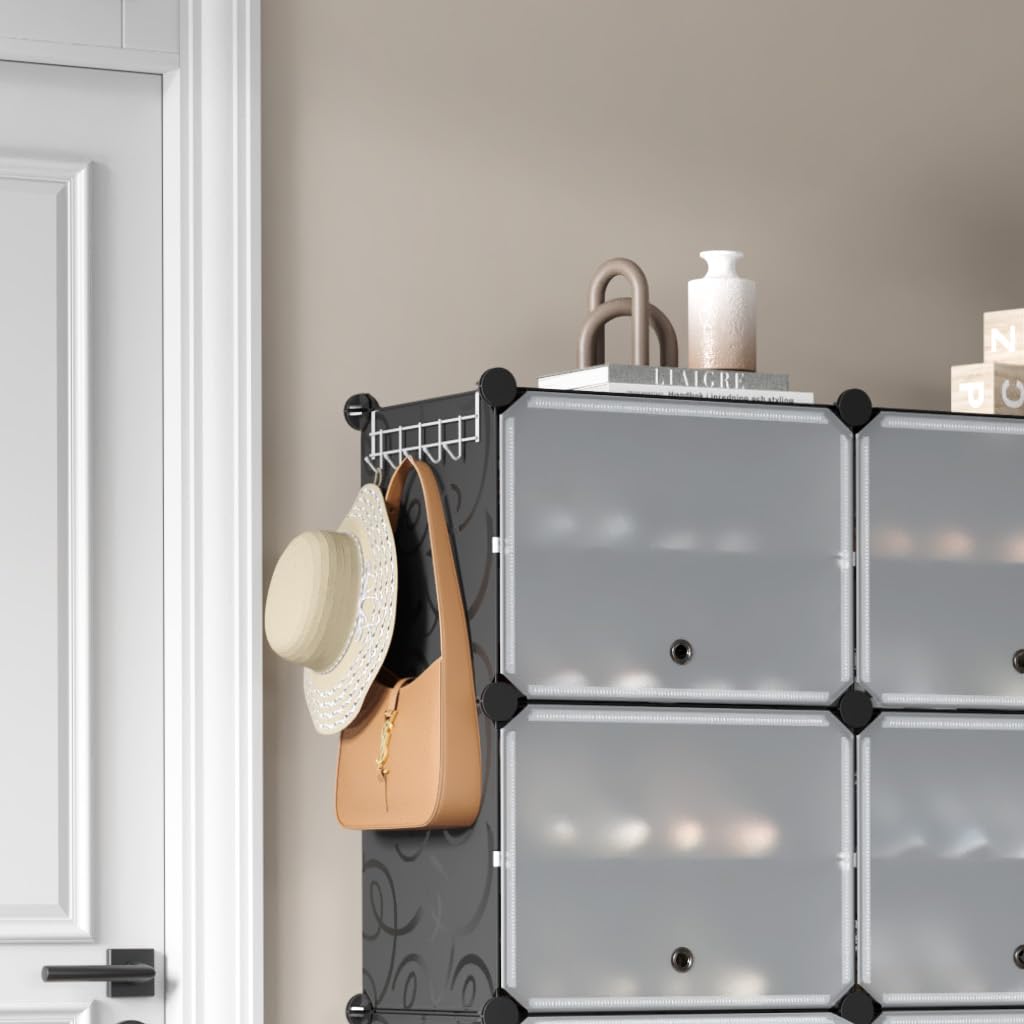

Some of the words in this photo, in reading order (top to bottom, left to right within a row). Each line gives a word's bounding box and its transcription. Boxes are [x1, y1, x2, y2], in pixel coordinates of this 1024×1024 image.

[655, 367, 745, 390] LIAIGRE
[959, 381, 985, 409] P
[1001, 379, 1024, 409] C
